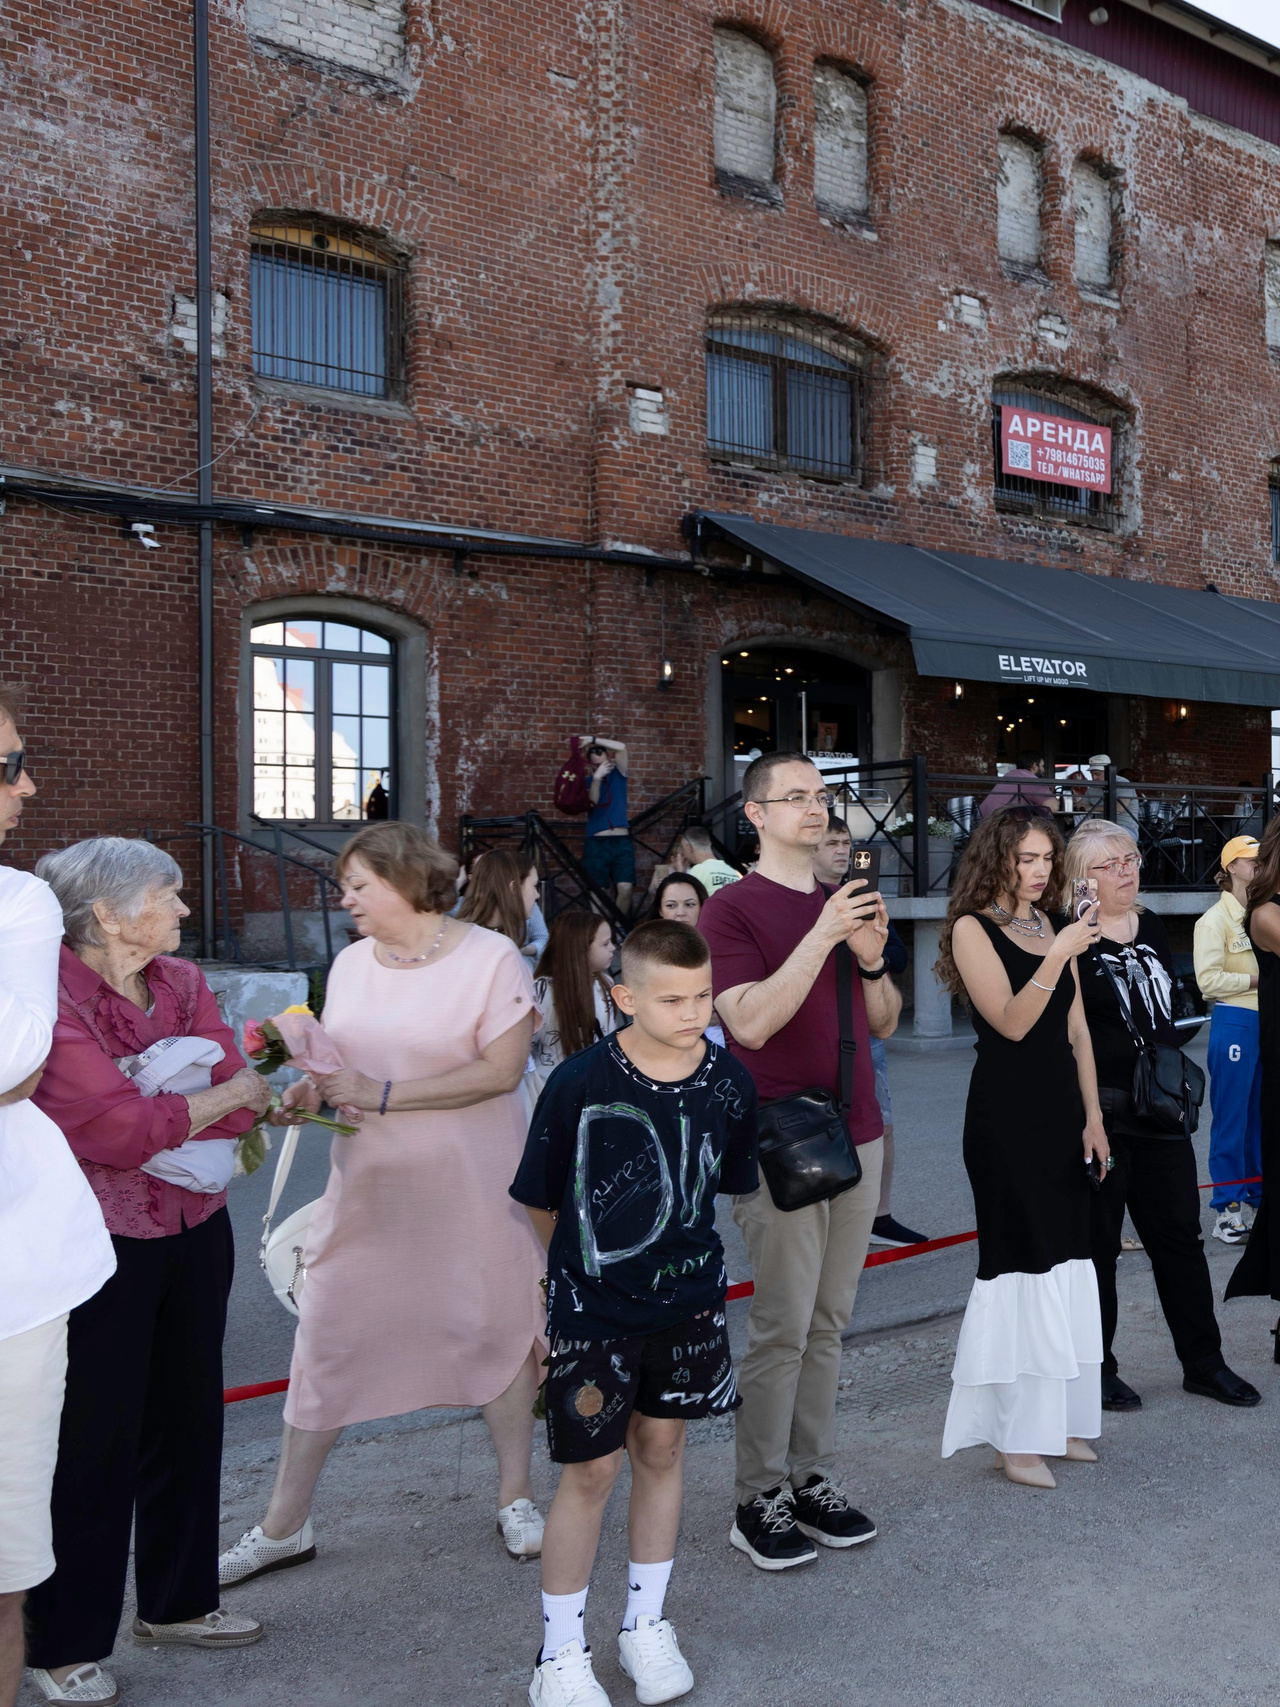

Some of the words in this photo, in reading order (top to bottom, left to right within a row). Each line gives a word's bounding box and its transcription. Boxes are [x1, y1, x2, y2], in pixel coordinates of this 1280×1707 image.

[1008, 414, 1105, 454] АРЕНДА
[1037, 446, 1105, 472] +79814675035
[1037, 460, 1106, 485] ТЕЛ./WHATSAPP
[998, 654, 1087, 677] ELEVATOR
[807, 750, 854, 760] ELEVATOR
[1229, 1044, 1241, 1062] G
